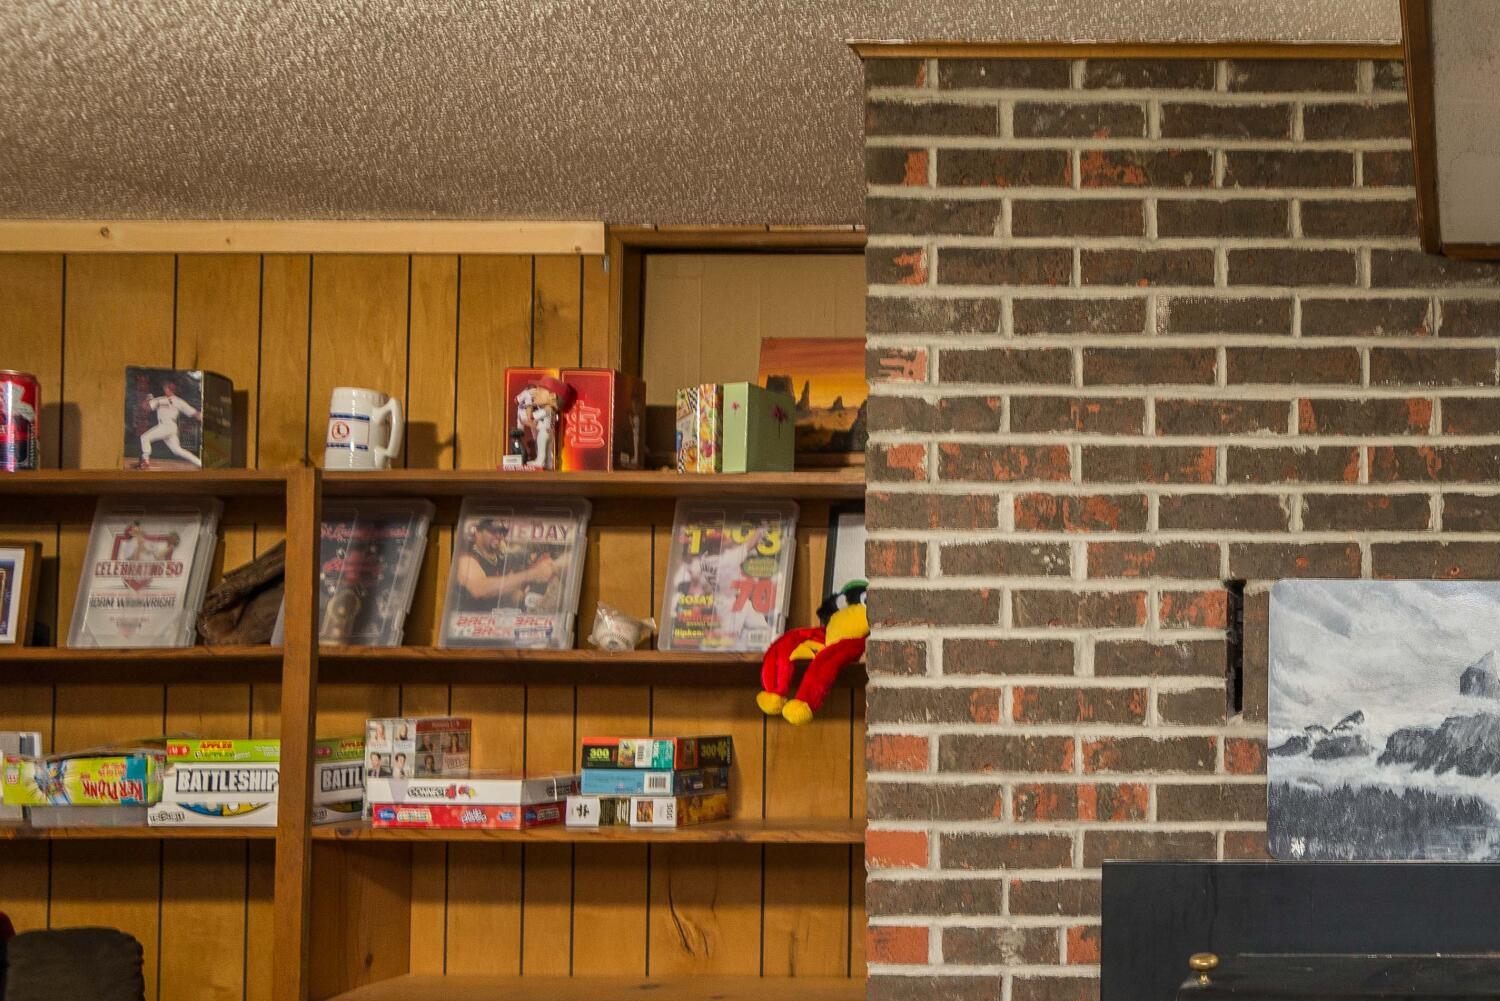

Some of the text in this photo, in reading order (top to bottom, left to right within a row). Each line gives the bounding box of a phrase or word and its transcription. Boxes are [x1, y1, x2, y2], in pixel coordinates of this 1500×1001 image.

[531, 520, 570, 540] DAY
[95, 560, 184, 576] CELEBRATING 50
[730, 577, 778, 614] 70
[175, 767, 280, 794] BATTLESHIP
[320, 766, 364, 793] BATTL
